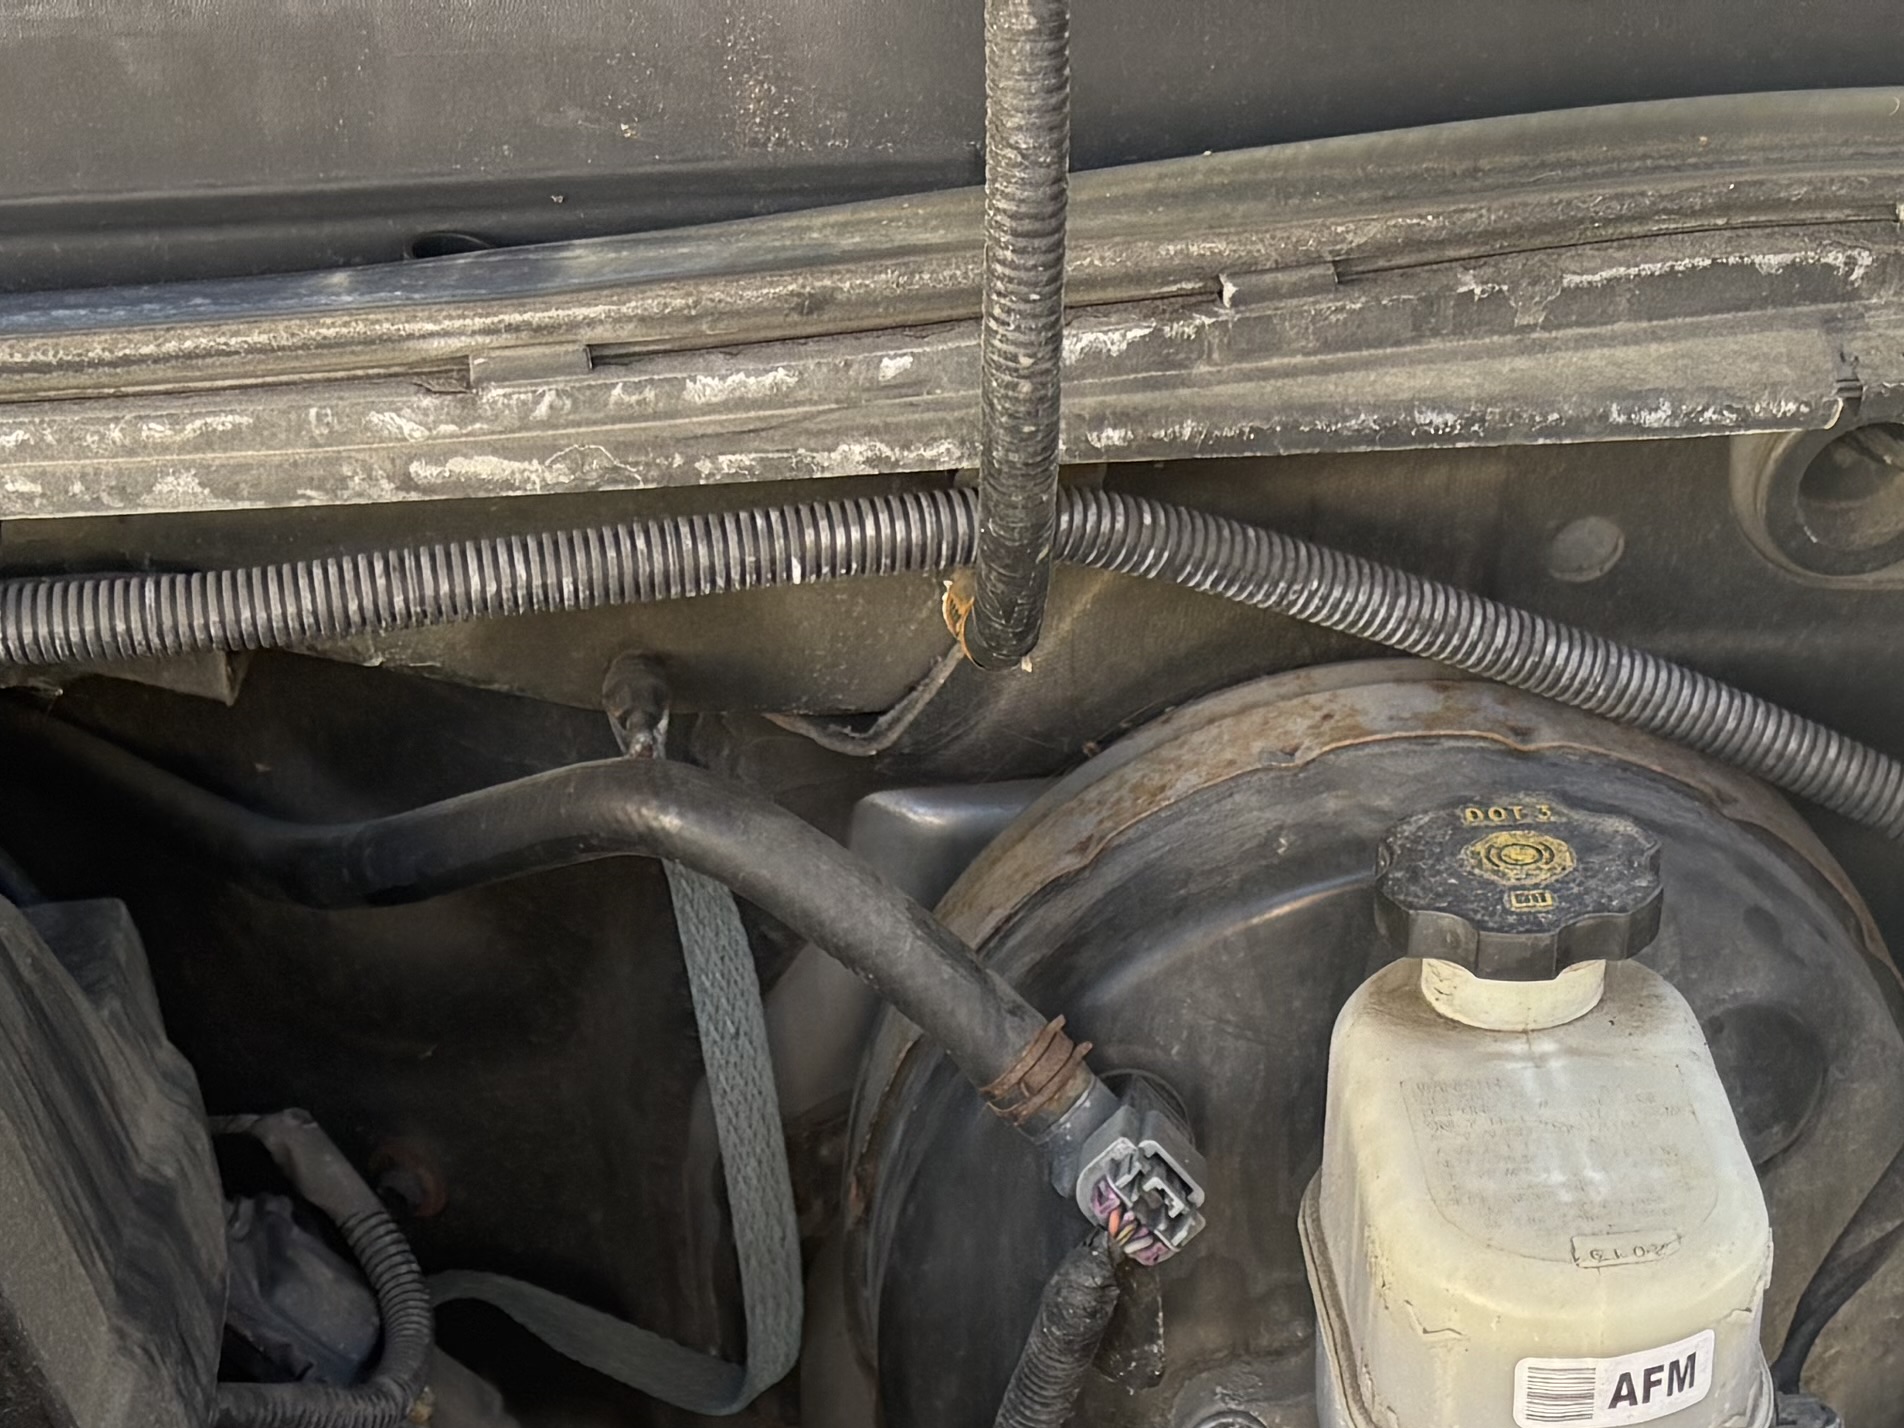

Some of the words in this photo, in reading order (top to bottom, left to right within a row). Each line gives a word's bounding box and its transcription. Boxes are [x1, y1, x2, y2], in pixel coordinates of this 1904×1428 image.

[1464, 805, 1523, 824] DOT
[1536, 804, 1552, 822] 3
[1607, 1351, 1697, 1410] AFM
